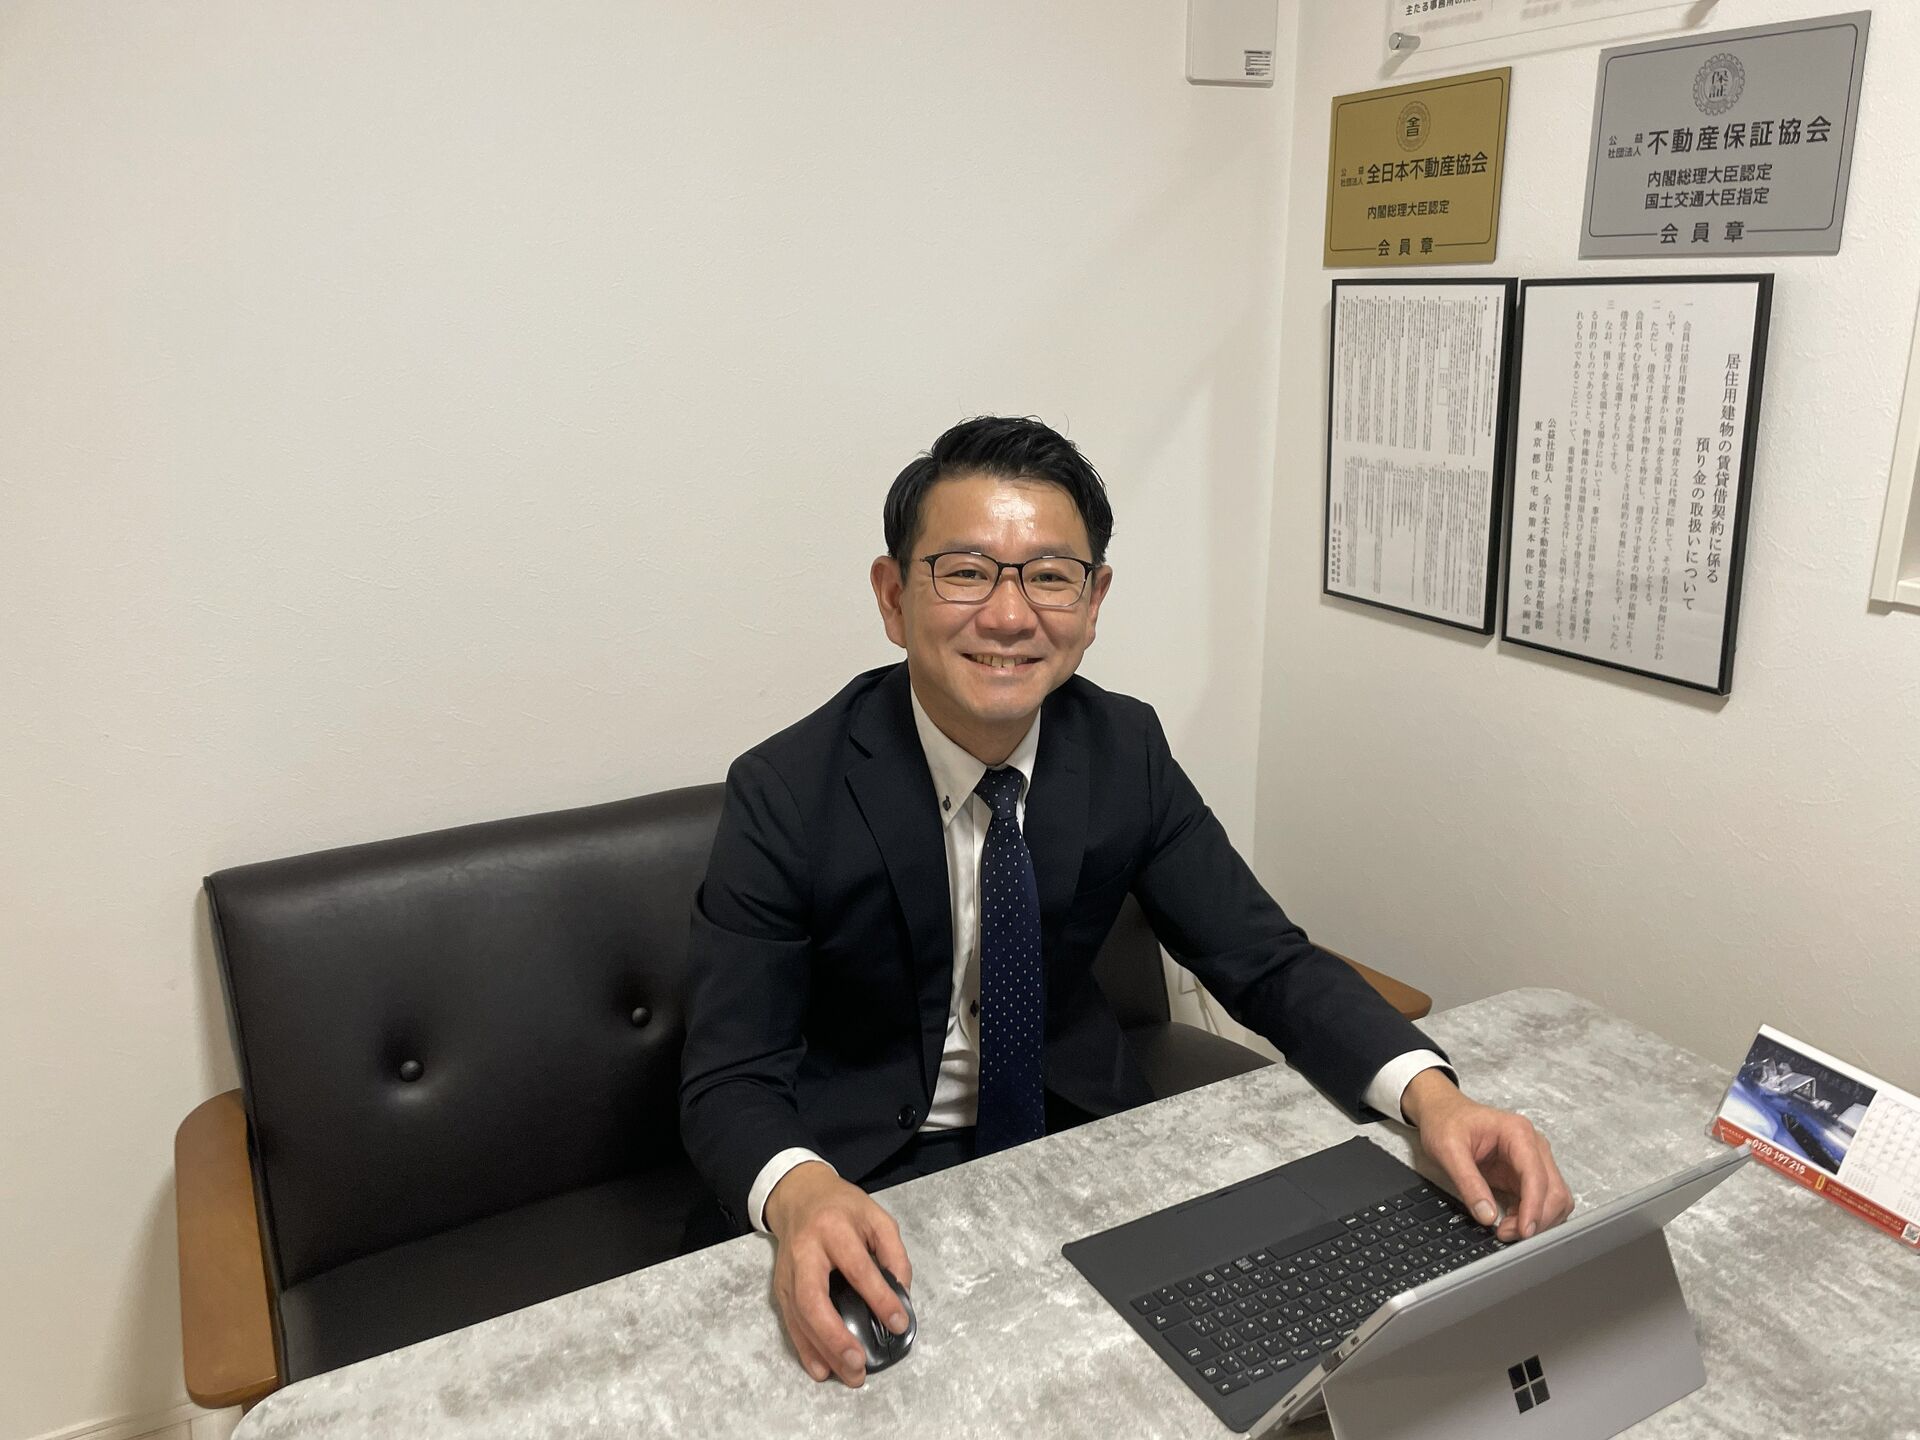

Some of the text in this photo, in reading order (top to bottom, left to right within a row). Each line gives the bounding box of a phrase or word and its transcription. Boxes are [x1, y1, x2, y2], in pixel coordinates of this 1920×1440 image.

[1708, 70, 1729, 98] 保証
[1647, 115, 1832, 155] 不動産保証協会
[1608, 146, 1642, 159] 社団法人
[1367, 151, 1488, 185] 全日本不動産協会
[1647, 163, 1773, 187] 内閣総理大臣認定
[1367, 200, 1450, 220] 内閣総理大臣認定
[1645, 187, 1770, 210] 国土交通大臣指定
[1660, 221, 1745, 244] 会員章
[1378, 237, 1434, 256] 会員章
[1706, 353, 1741, 584] 居住用建物の賃貸借契約に係る
[1682, 437, 1710, 611] 預り金の取扱いについて
